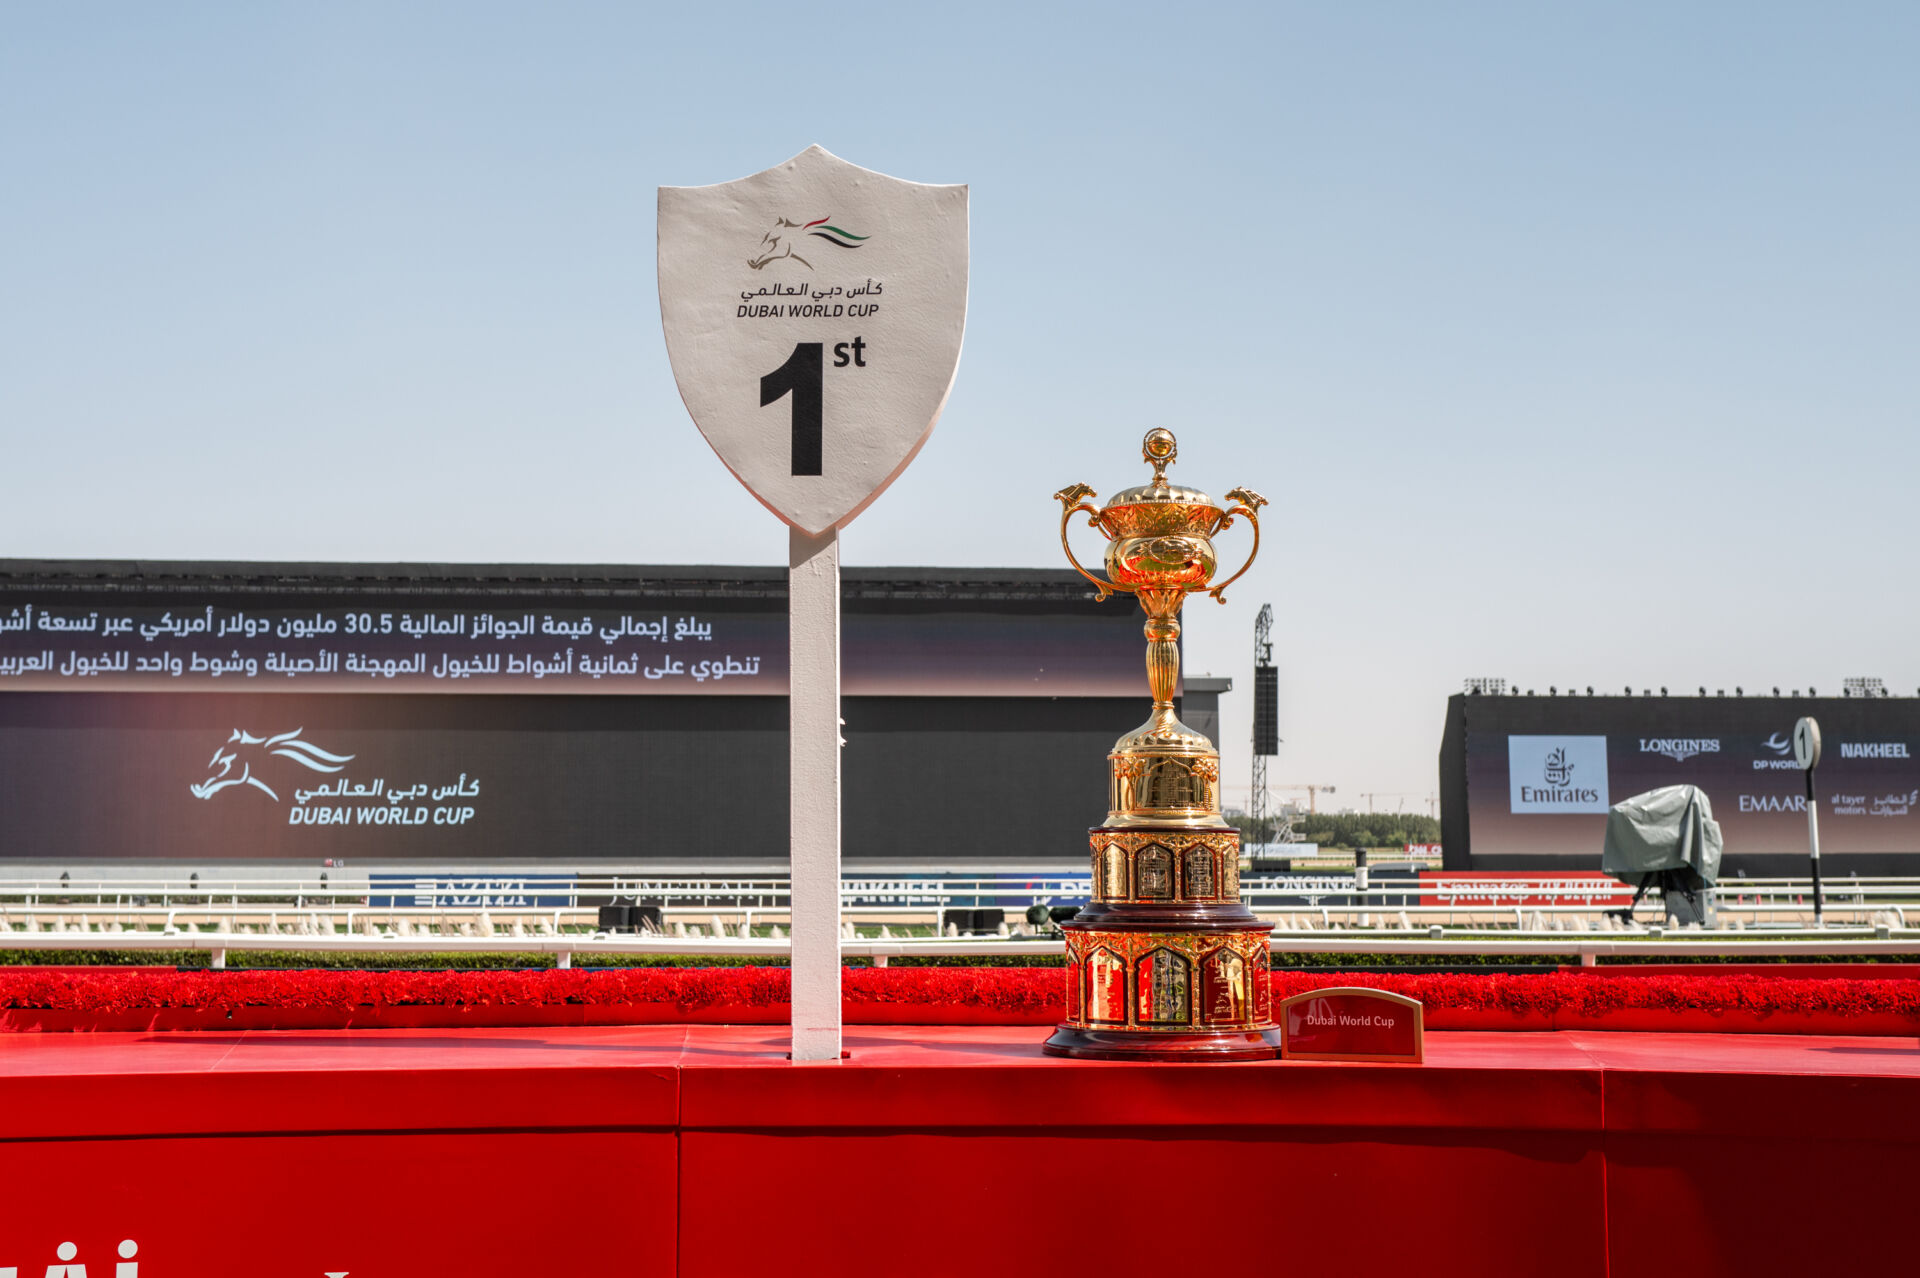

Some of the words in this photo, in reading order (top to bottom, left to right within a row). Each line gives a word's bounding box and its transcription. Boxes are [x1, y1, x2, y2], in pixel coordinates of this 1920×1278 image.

[741, 283, 808, 302] العالمي
[811, 286, 842, 302] دبي
[846, 278, 883, 298] كأس
[737, 305, 784, 318] DUBAI
[788, 304, 843, 317] WORLD
[848, 304, 879, 317] CUP
[37, 611, 98, 632] تسعة
[102, 616, 133, 636] عبر
[139, 605, 214, 641] أمريكي
[218, 612, 270, 637] دولار
[277, 613, 337, 638] مليون
[345, 613, 393, 634] 30.5
[400, 614, 465, 639] المالية
[471, 613, 535, 639] الجوائز
[542, 615, 593, 640] قيمة
[600, 616, 668, 645] إجمالي
[674, 616, 712, 641] يبلغ
[60, 651, 129, 676] للخيول
[136, 651, 182, 676] واحد
[189, 649, 257, 677] وشوط
[264, 649, 338, 677] الأصيلة
[345, 652, 426, 678] المهجنة
[432, 653, 500, 678] للخيول
[506, 647, 573, 679] أشواط
[579, 652, 639, 679] ثمانية
[643, 654, 684, 679] على
[690, 655, 760, 682] تنطوي
[1640, 739, 1720, 752] LONGINES
[1799, 727, 1806, 760] 1
[1840, 742, 1910, 758] NAKHEEL
[1753, 760, 1768, 769] DP
[1769, 760, 1801, 769] WORL
[295, 779, 384, 805] العالمي
[387, 784, 428, 805] دبي
[432, 773, 480, 800] كأس
[1521, 786, 1598, 803] Emirates
[1739, 794, 1807, 812] EMAAR
[1834, 804, 1866, 815] motors
[1841, 795, 1866, 808] tayer
[288, 807, 351, 825] DUBAI
[356, 807, 428, 825] WORLD
[433, 807, 475, 825] CUP
[1261, 876, 1357, 890] LONGINE
[1307, 1015, 1337, 1026] Dubai
[1340, 1015, 1371, 1026] World
[1374, 1015, 1395, 1029] Cup
